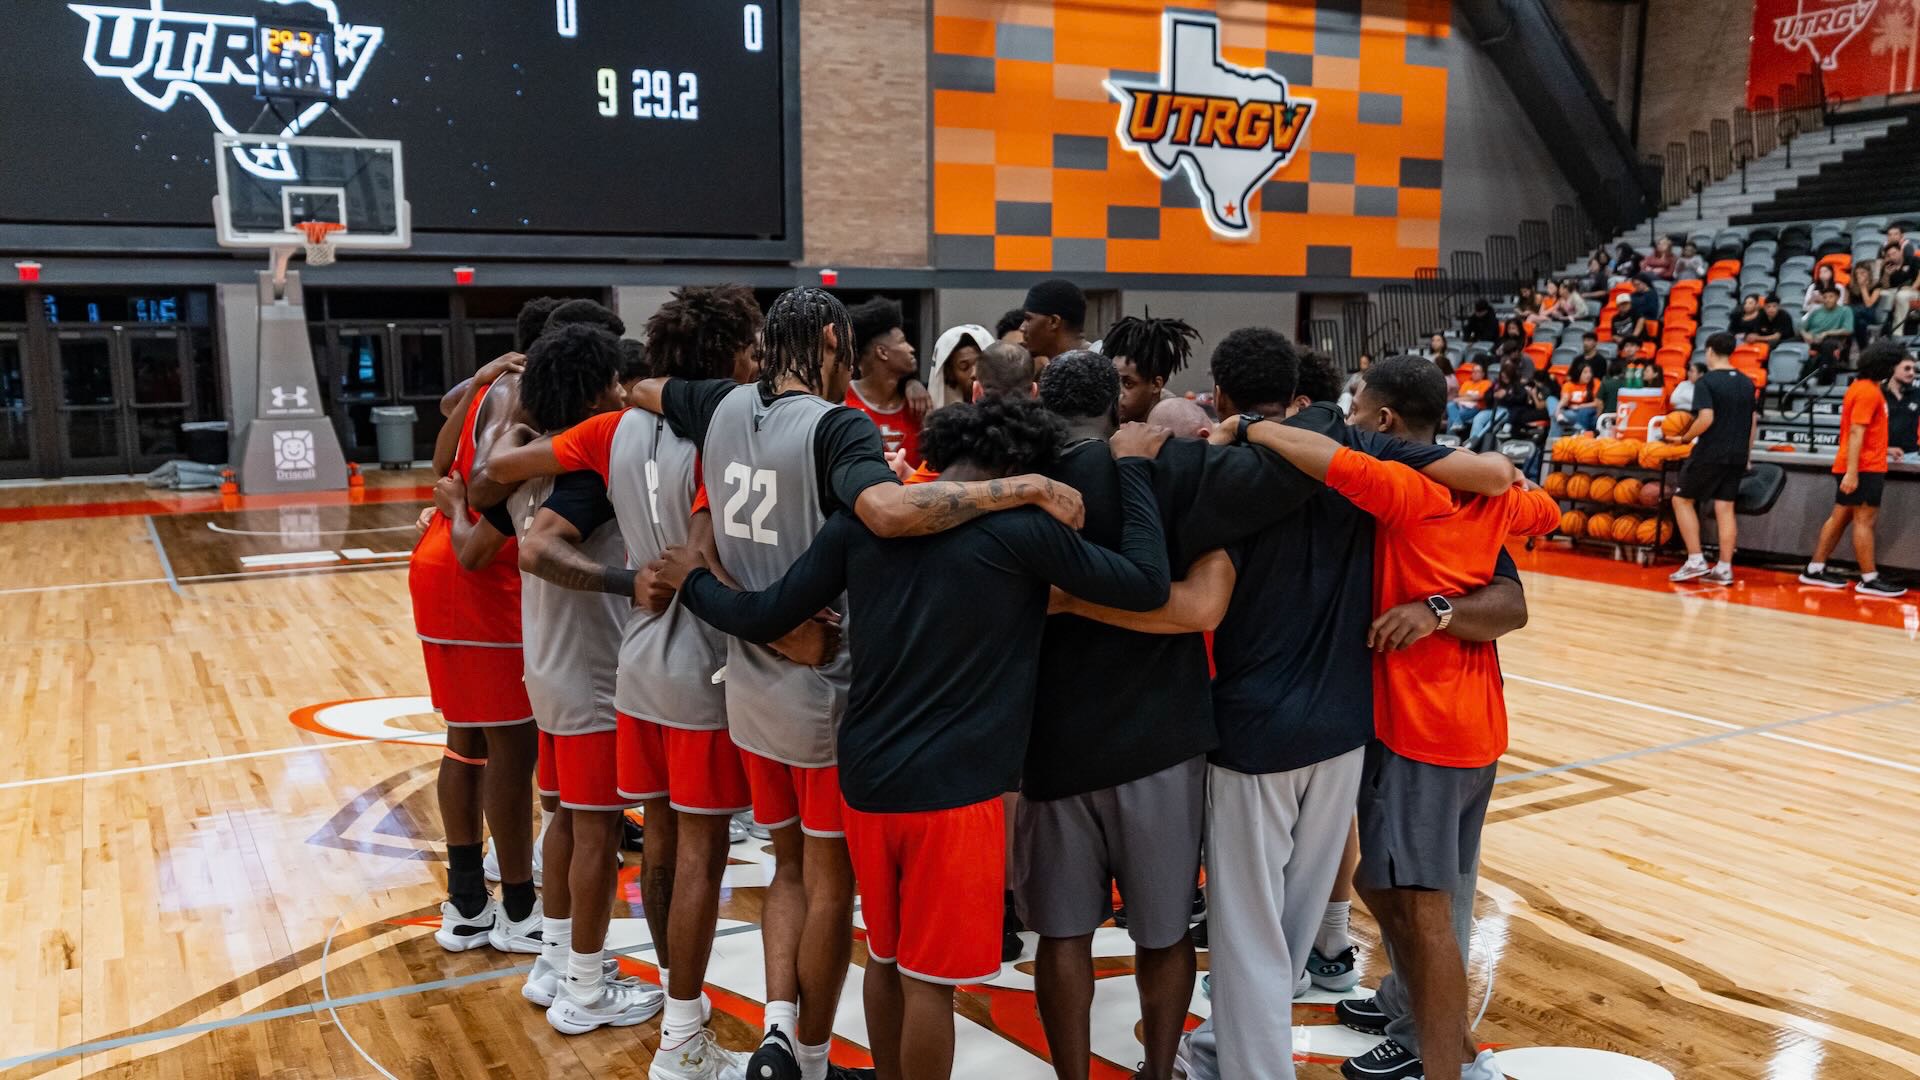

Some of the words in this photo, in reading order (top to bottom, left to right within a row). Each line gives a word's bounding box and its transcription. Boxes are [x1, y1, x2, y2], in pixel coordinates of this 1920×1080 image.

[743, 4, 763, 51] 0
[1775, 4, 1875, 42] UTRGV
[597, 68, 617, 116] 9
[632, 69, 698, 120] 29.2
[1127, 90, 1312, 151] UTRGV
[723, 461, 778, 546] 22
